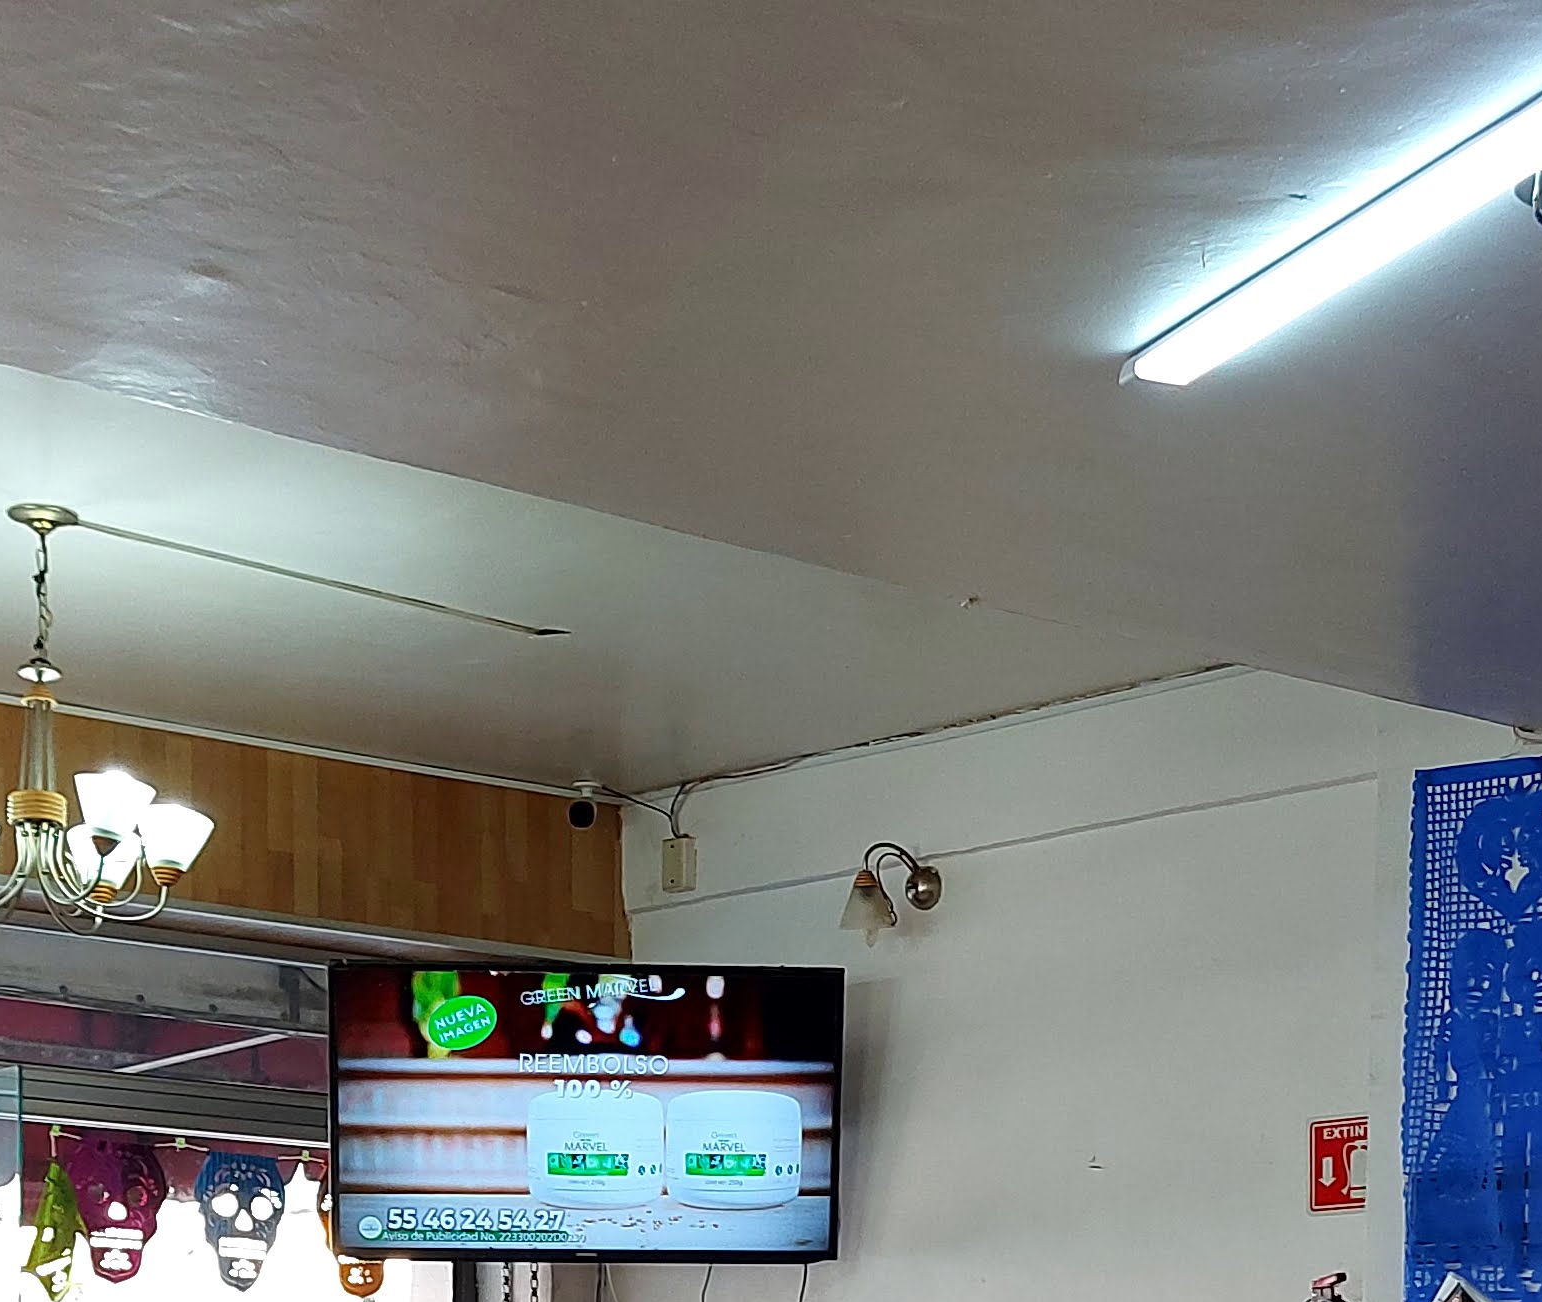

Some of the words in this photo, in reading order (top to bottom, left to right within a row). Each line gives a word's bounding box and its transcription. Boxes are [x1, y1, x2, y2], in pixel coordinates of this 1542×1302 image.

[520, 986, 581, 1006] GREEN
[434, 1003, 487, 1031] NUEVA
[439, 1015, 491, 1043] IMAGEN
[519, 1053, 670, 1075] REEMBOLSO
[554, 1079, 601, 1099] 100
[610, 1080, 633, 1098] %
[1322, 1125, 1368, 1140] EXTIN
[564, 1141, 608, 1152] MARVEL
[702, 1142, 746, 1152] MARVEL
[387, 1208, 418, 1231] 55
[422, 1208, 456, 1231] 46
[460, 1208, 493, 1231] 24
[497, 1208, 531, 1231] 54
[533, 1209, 565, 1232] 27
[382, 1231, 409, 1241] Aviso
[410, 1231, 424, 1241] de
[426, 1231, 478, 1241] Publicidad
[480, 1231, 497, 1241] No.
